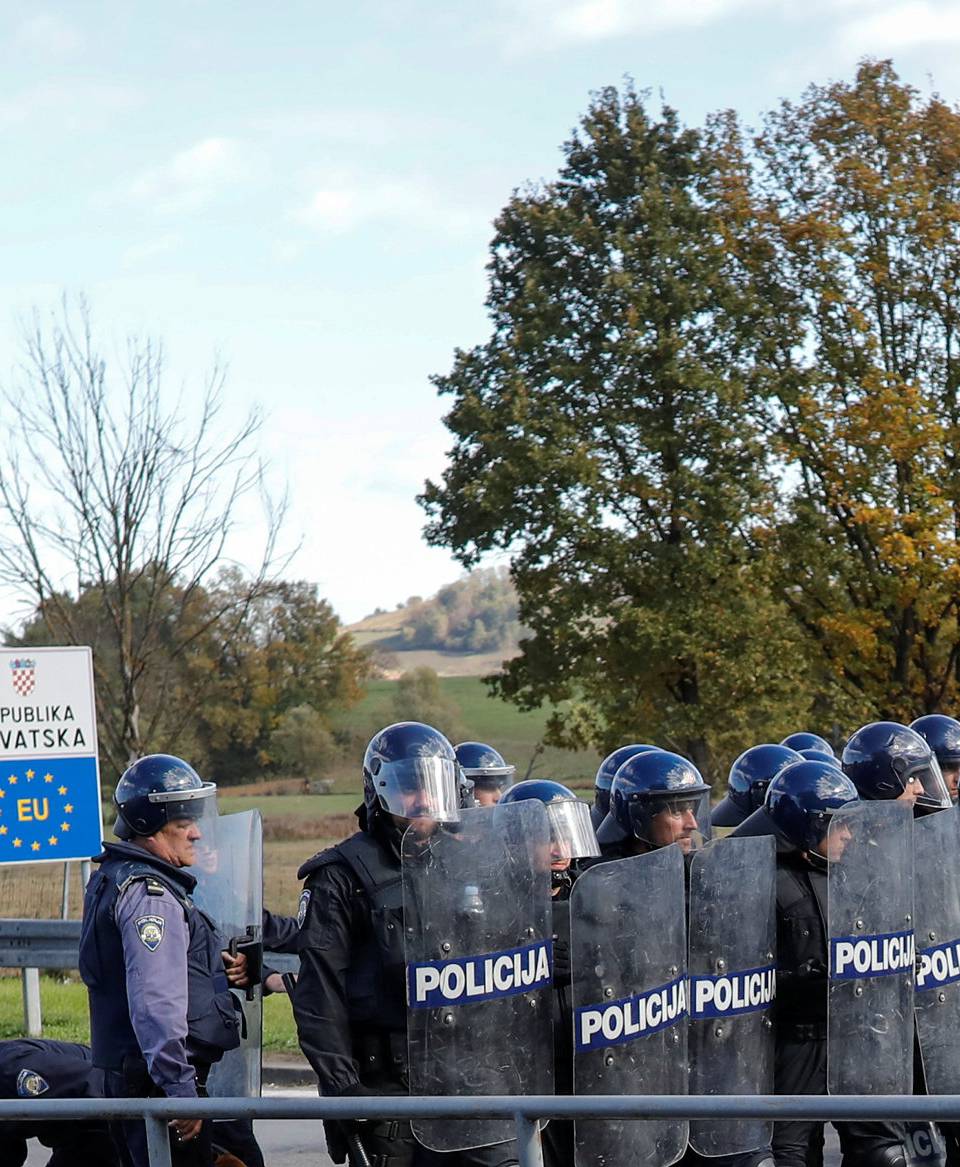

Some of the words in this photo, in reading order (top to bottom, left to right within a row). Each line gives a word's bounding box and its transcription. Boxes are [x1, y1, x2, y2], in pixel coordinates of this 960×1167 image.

[17, 798, 49, 821] EU
[415, 946, 550, 1002] POLICIJA
[581, 978, 687, 1045] POLICIJA
